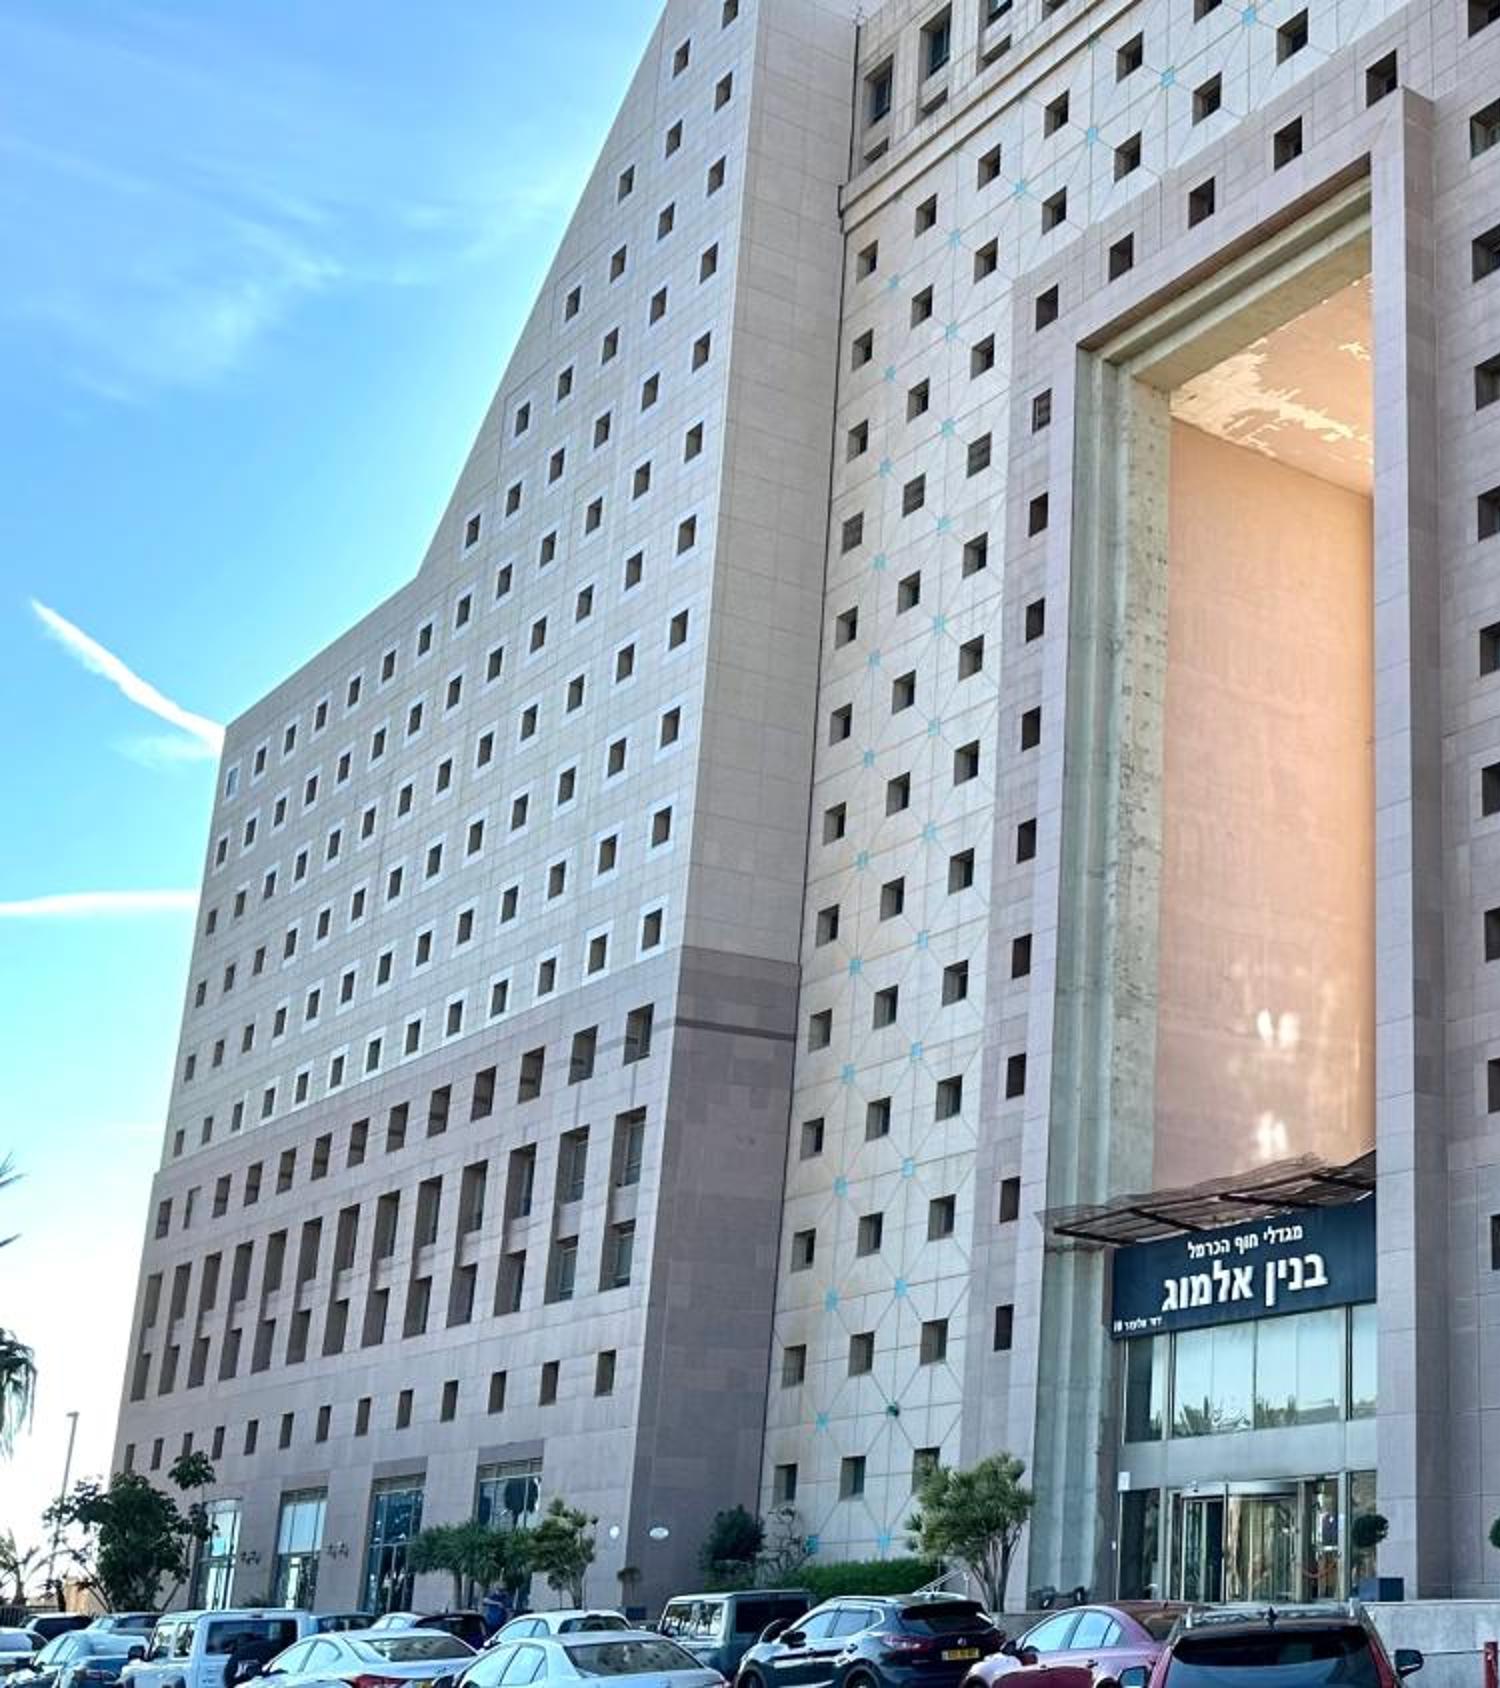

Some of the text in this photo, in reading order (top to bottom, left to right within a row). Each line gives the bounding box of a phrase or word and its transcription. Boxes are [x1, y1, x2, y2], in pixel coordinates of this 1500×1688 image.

[1187, 1224, 1303, 1259] מגדלי חוף הכרמל
[1161, 1253, 1328, 1312] בנין אלמוג
